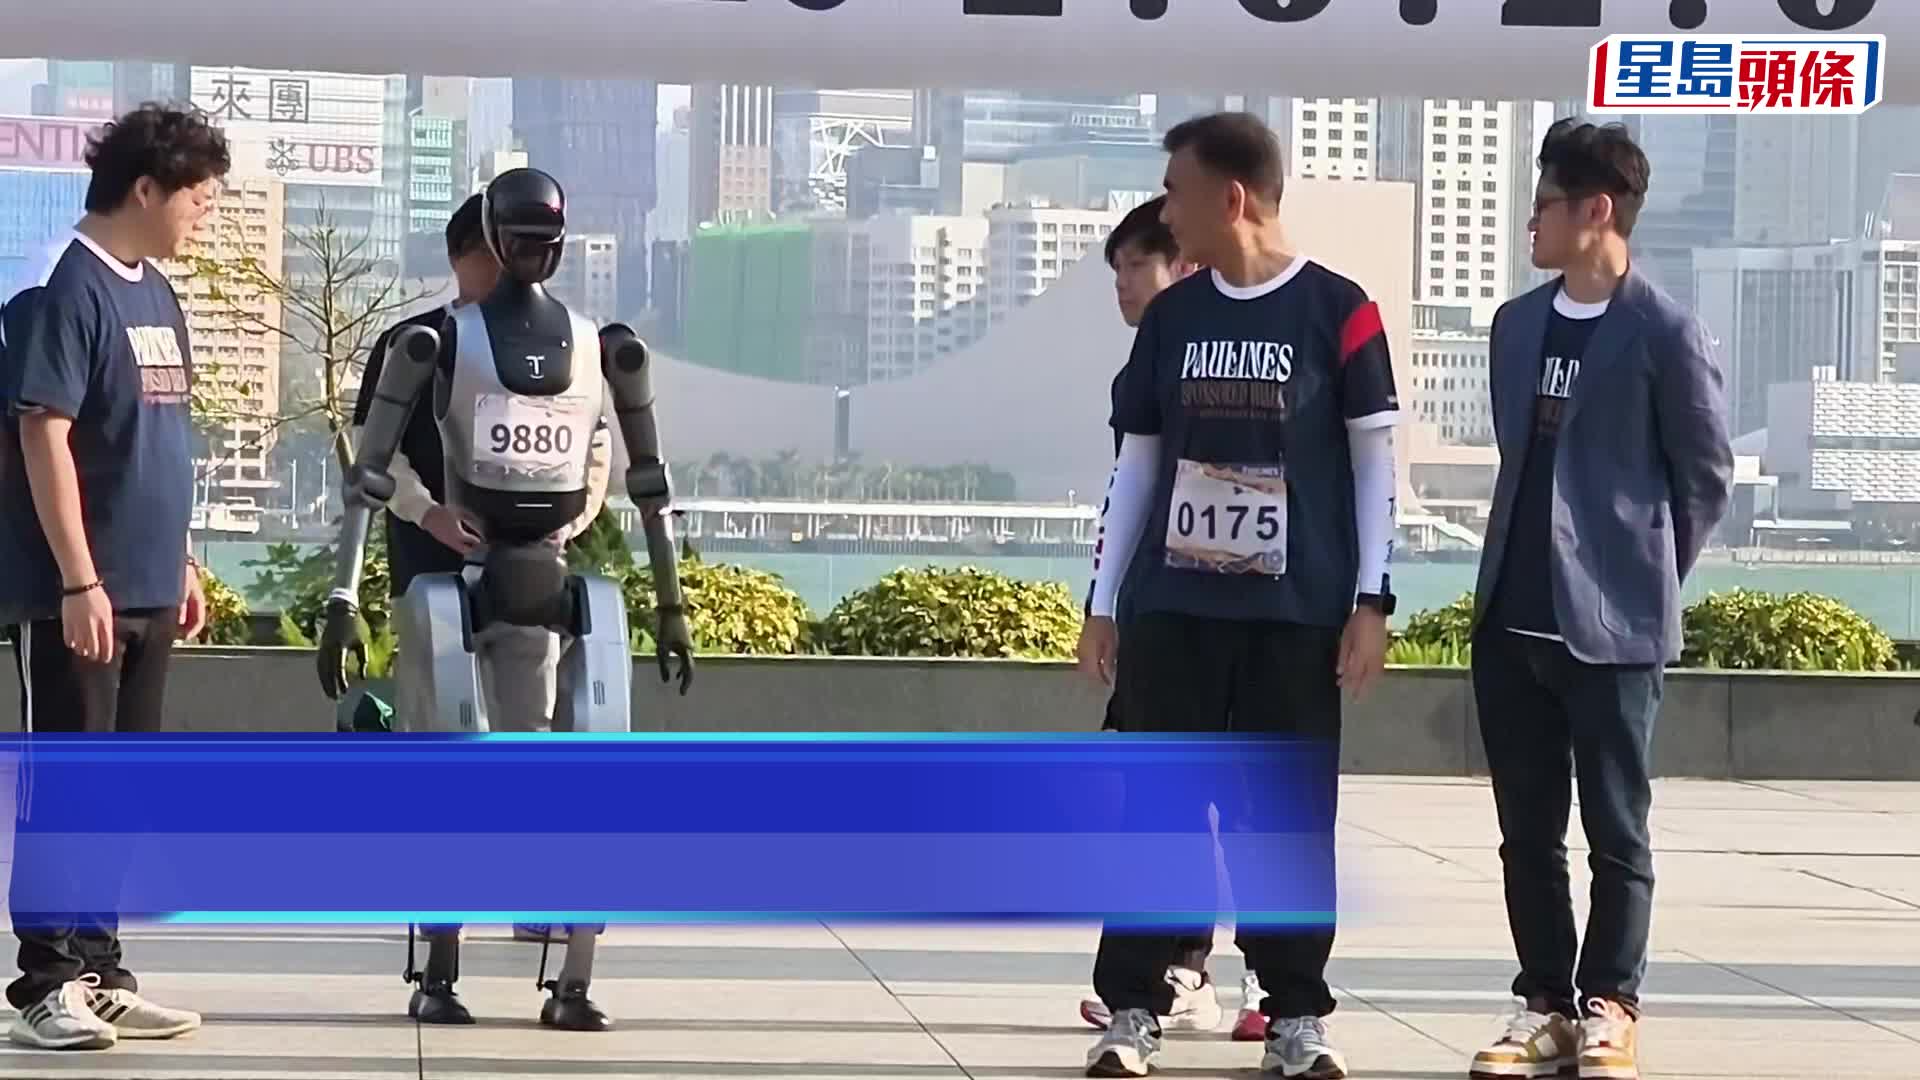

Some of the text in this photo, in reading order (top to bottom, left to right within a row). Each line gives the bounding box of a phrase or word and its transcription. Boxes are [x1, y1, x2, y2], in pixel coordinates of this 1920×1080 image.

[308, 143, 375, 173] UBS
[1180, 341, 1294, 382] PAULINES
[490, 423, 573, 454] 9880
[1177, 501, 1280, 541] 0175
